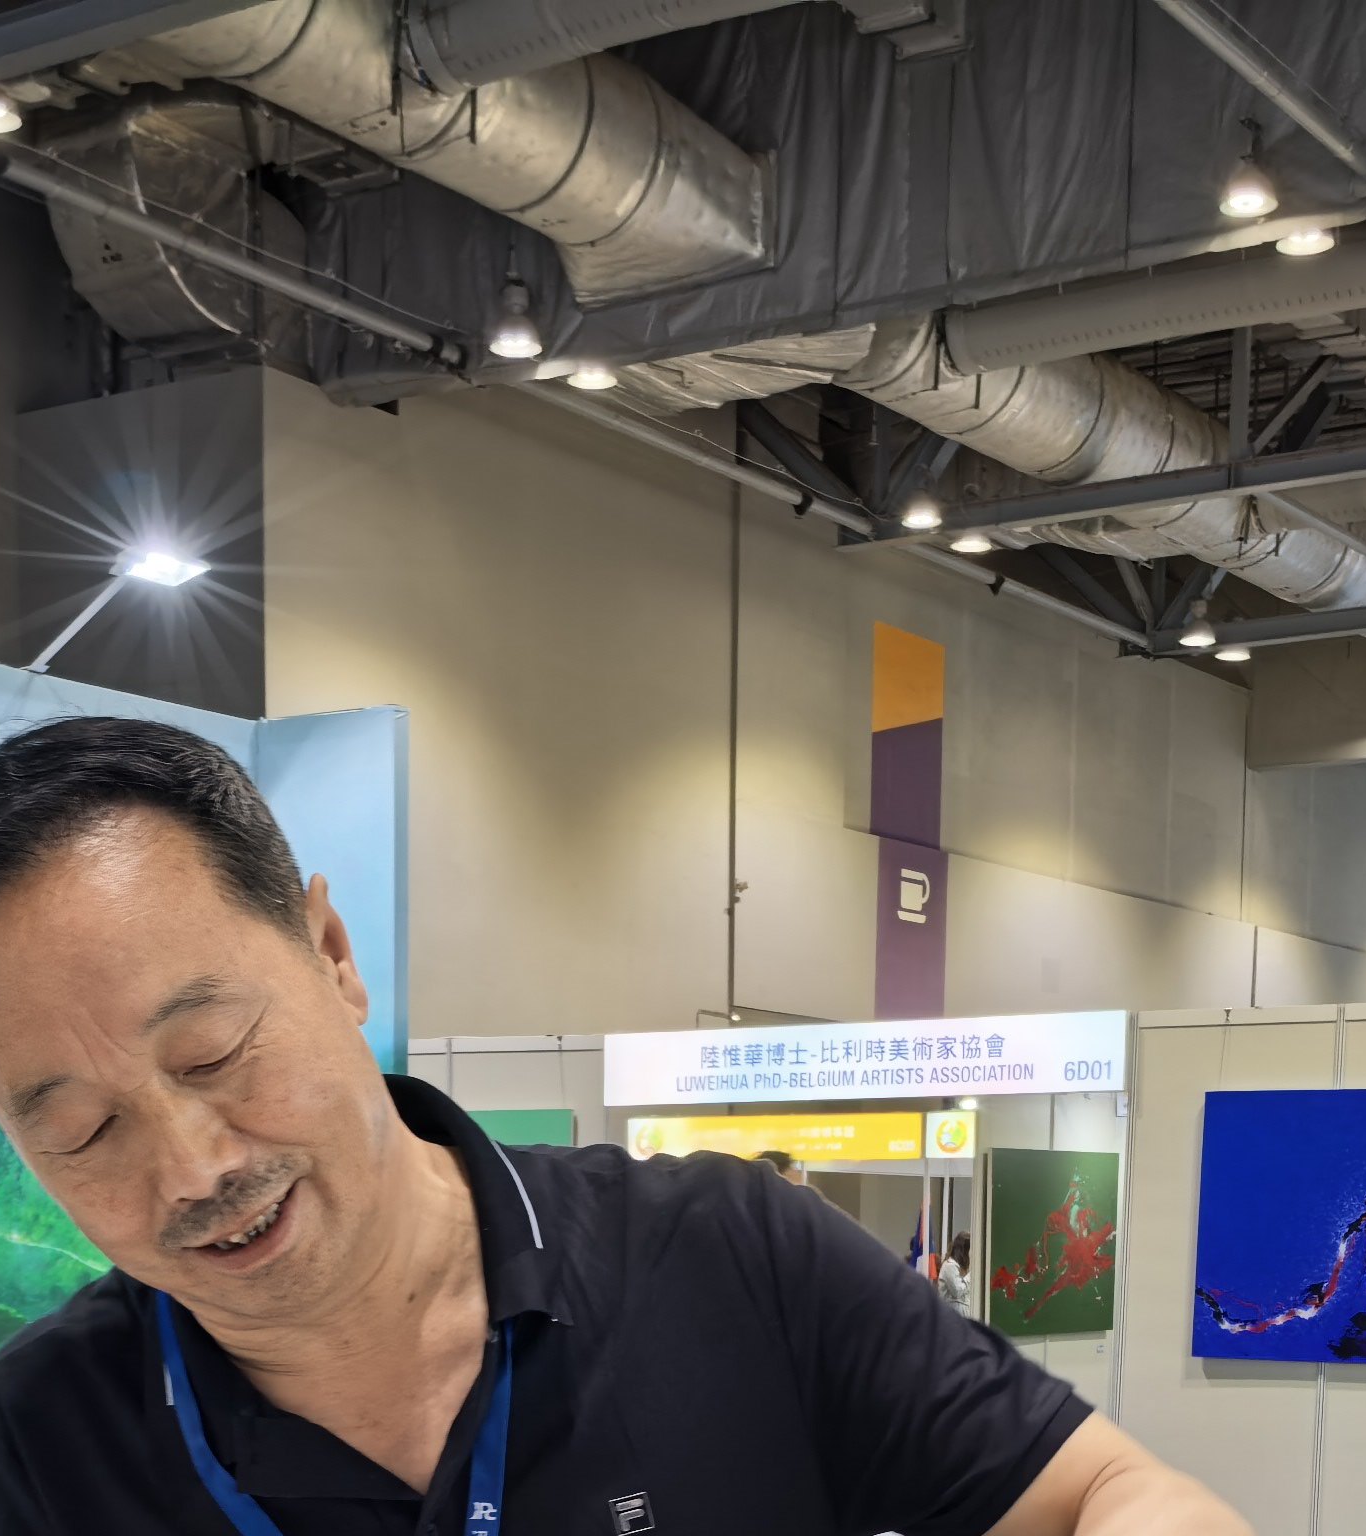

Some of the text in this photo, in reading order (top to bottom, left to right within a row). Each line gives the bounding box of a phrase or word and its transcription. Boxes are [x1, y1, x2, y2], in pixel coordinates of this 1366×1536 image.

[676, 1063, 1035, 1092] LUWEIHUA PhD-BELGIUM ARTISTS ASSOCIATION
[1063, 1059, 1113, 1081] 6D01
